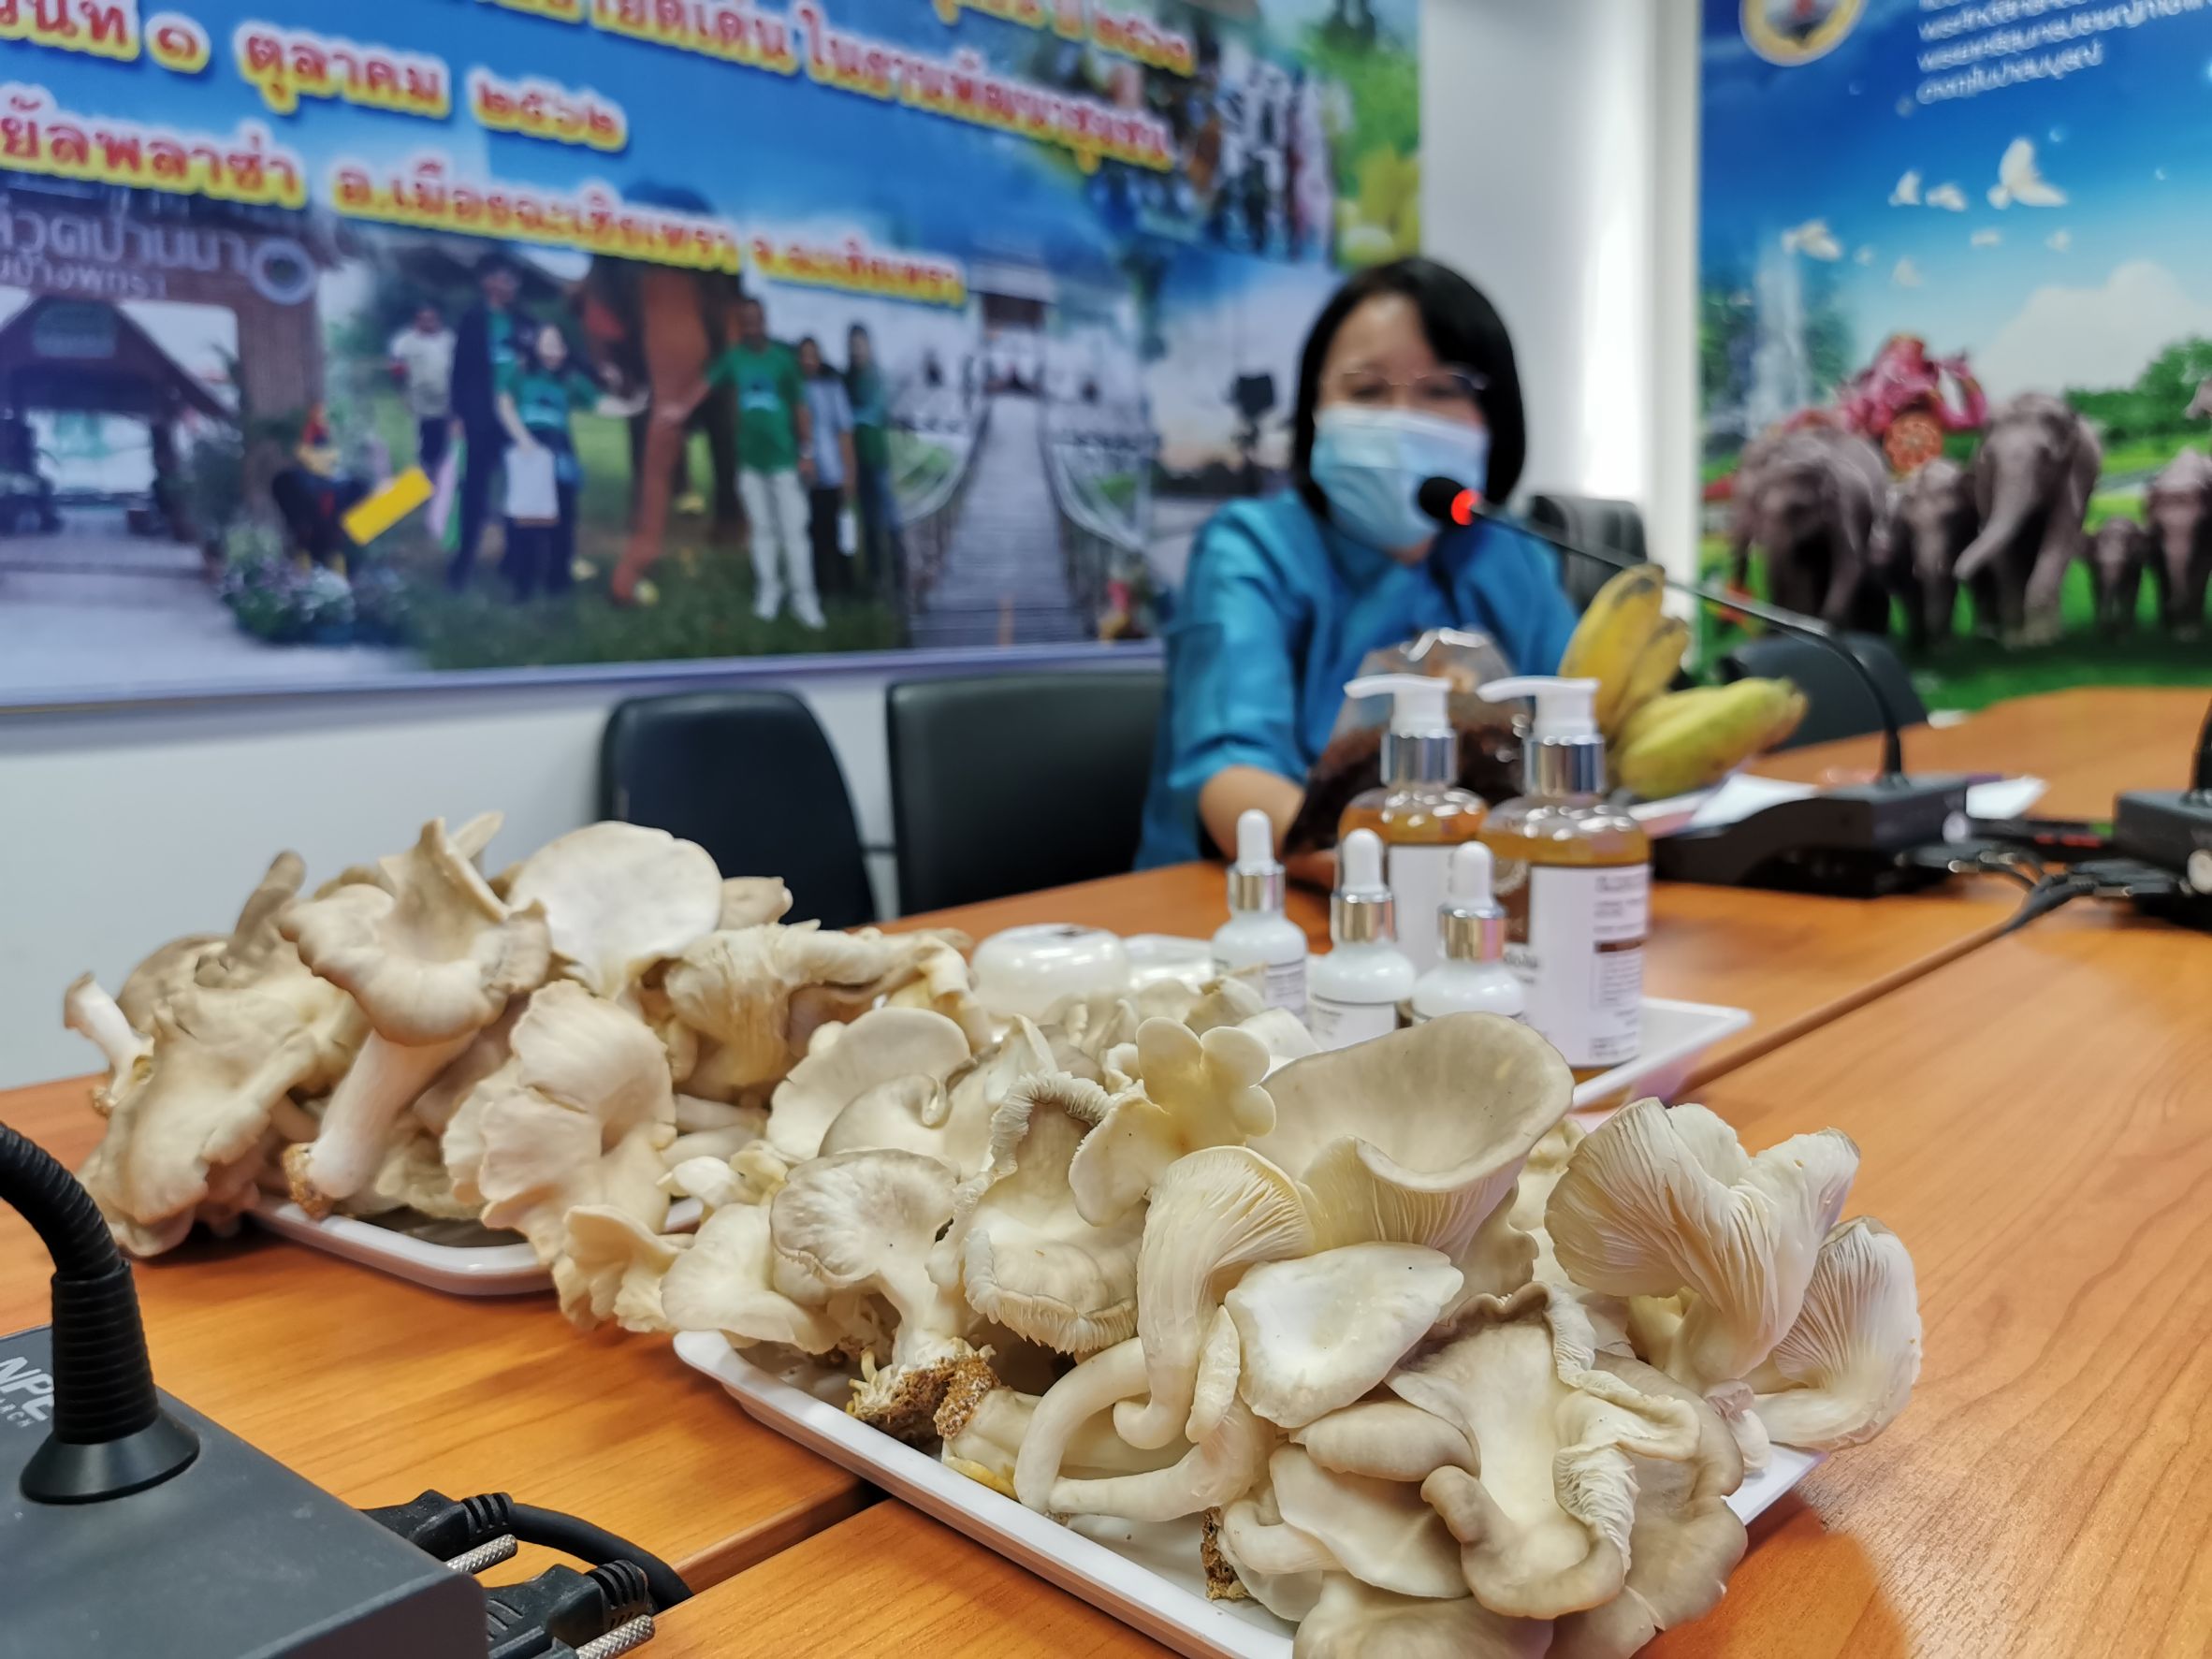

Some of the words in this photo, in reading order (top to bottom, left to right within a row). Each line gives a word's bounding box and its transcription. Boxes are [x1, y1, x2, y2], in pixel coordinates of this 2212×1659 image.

[240, 28, 447, 111] ตุลาคม
[0, 91, 302, 202] ยัลพลาซ่า
